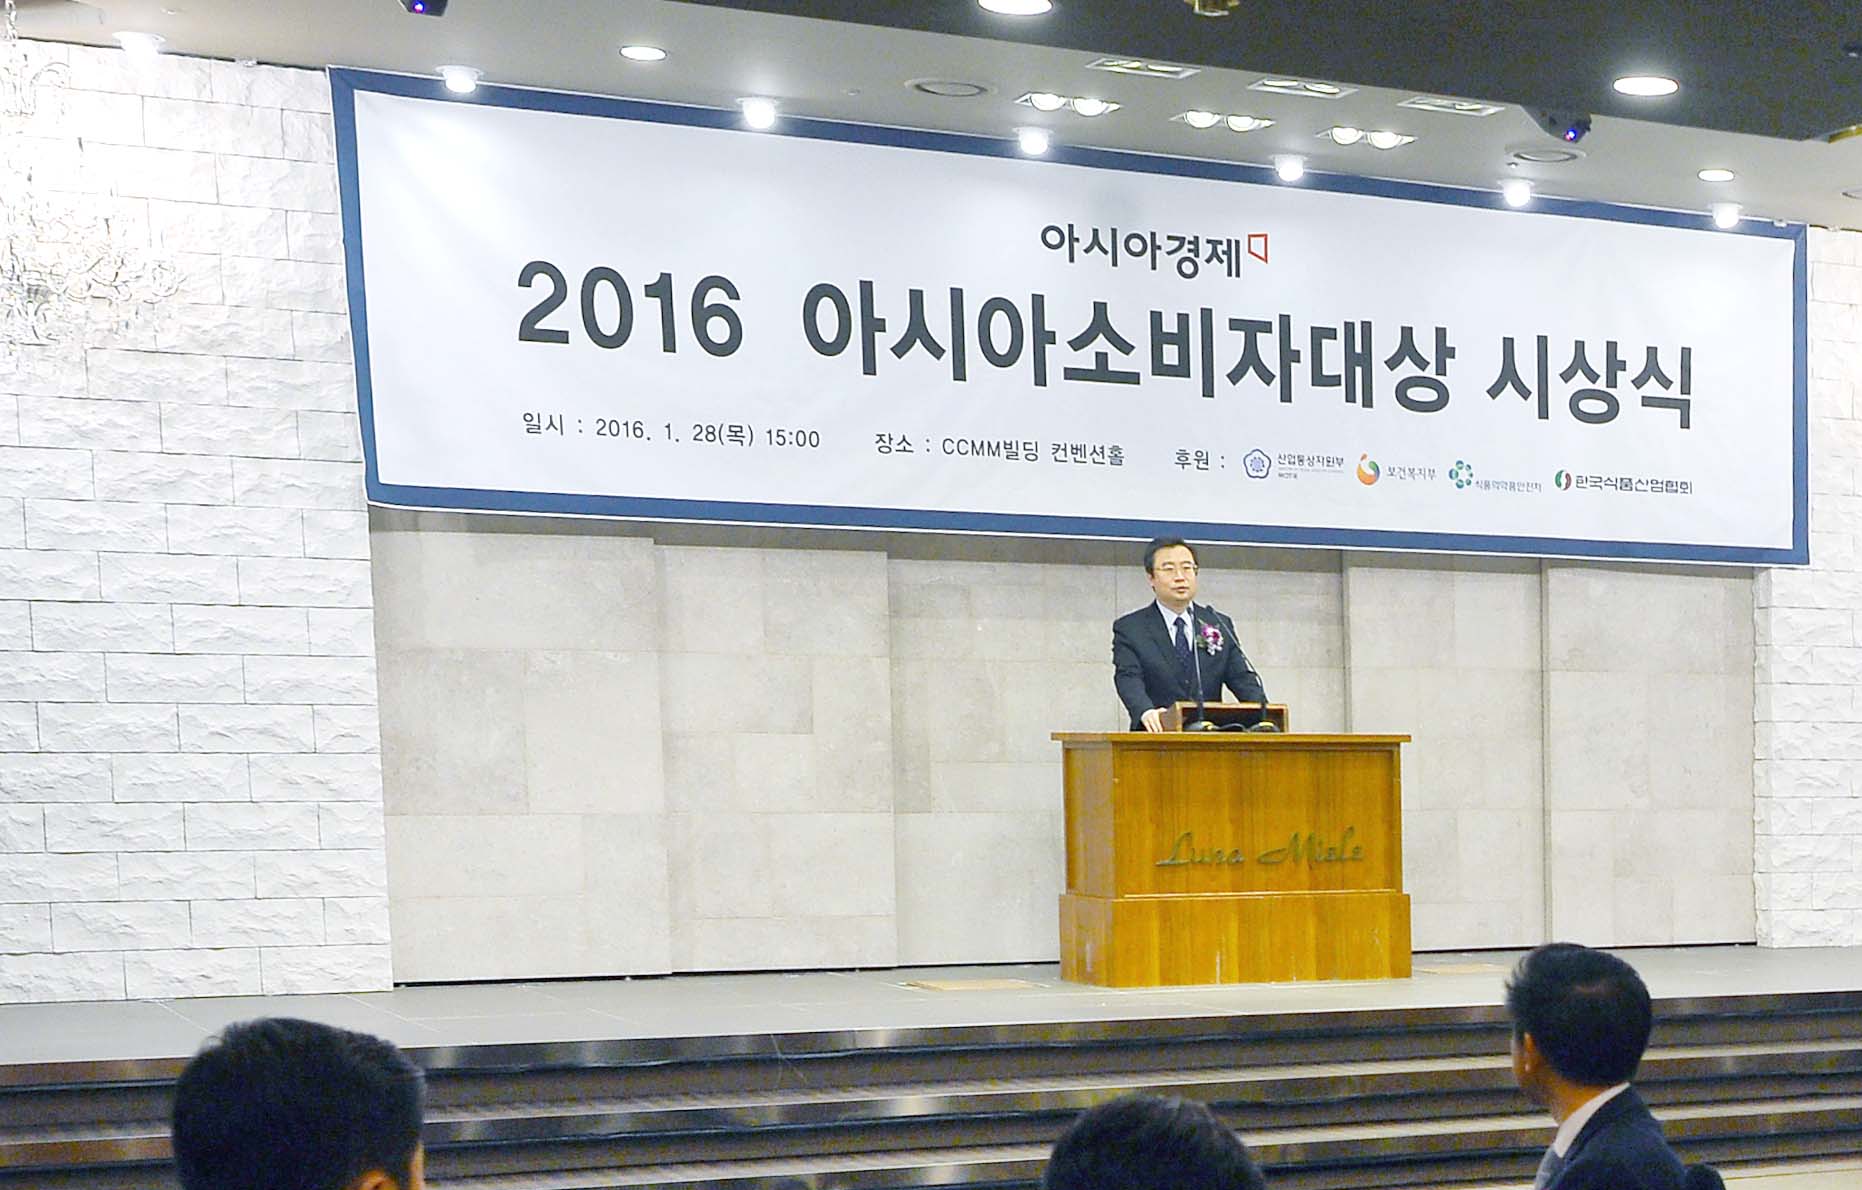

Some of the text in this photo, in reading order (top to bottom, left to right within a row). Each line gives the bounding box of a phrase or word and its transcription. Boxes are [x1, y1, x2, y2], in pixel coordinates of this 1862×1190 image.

[1041, 223, 1241, 280] 아시아경제
[518, 260, 1692, 430] 2016 아시아소비자대상 시상식
[522, 412, 564, 436] 일시
[595, 418, 651, 441] 2016.
[664, 422, 680, 443] 1.
[692, 423, 754, 447] 28(목)
[766, 428, 820, 448] 15:00
[874, 432, 915, 455] 장소
[942, 438, 1039, 462] CCMM빌딩
[1051, 442, 1125, 467] 컨벤션홀
[1174, 448, 1209, 471] 후원
[1277, 453, 1344, 468] 산업통상자원부
[1387, 465, 1437, 481] 보건복지부
[1575, 475, 1693, 495] 한국식품산업협회
